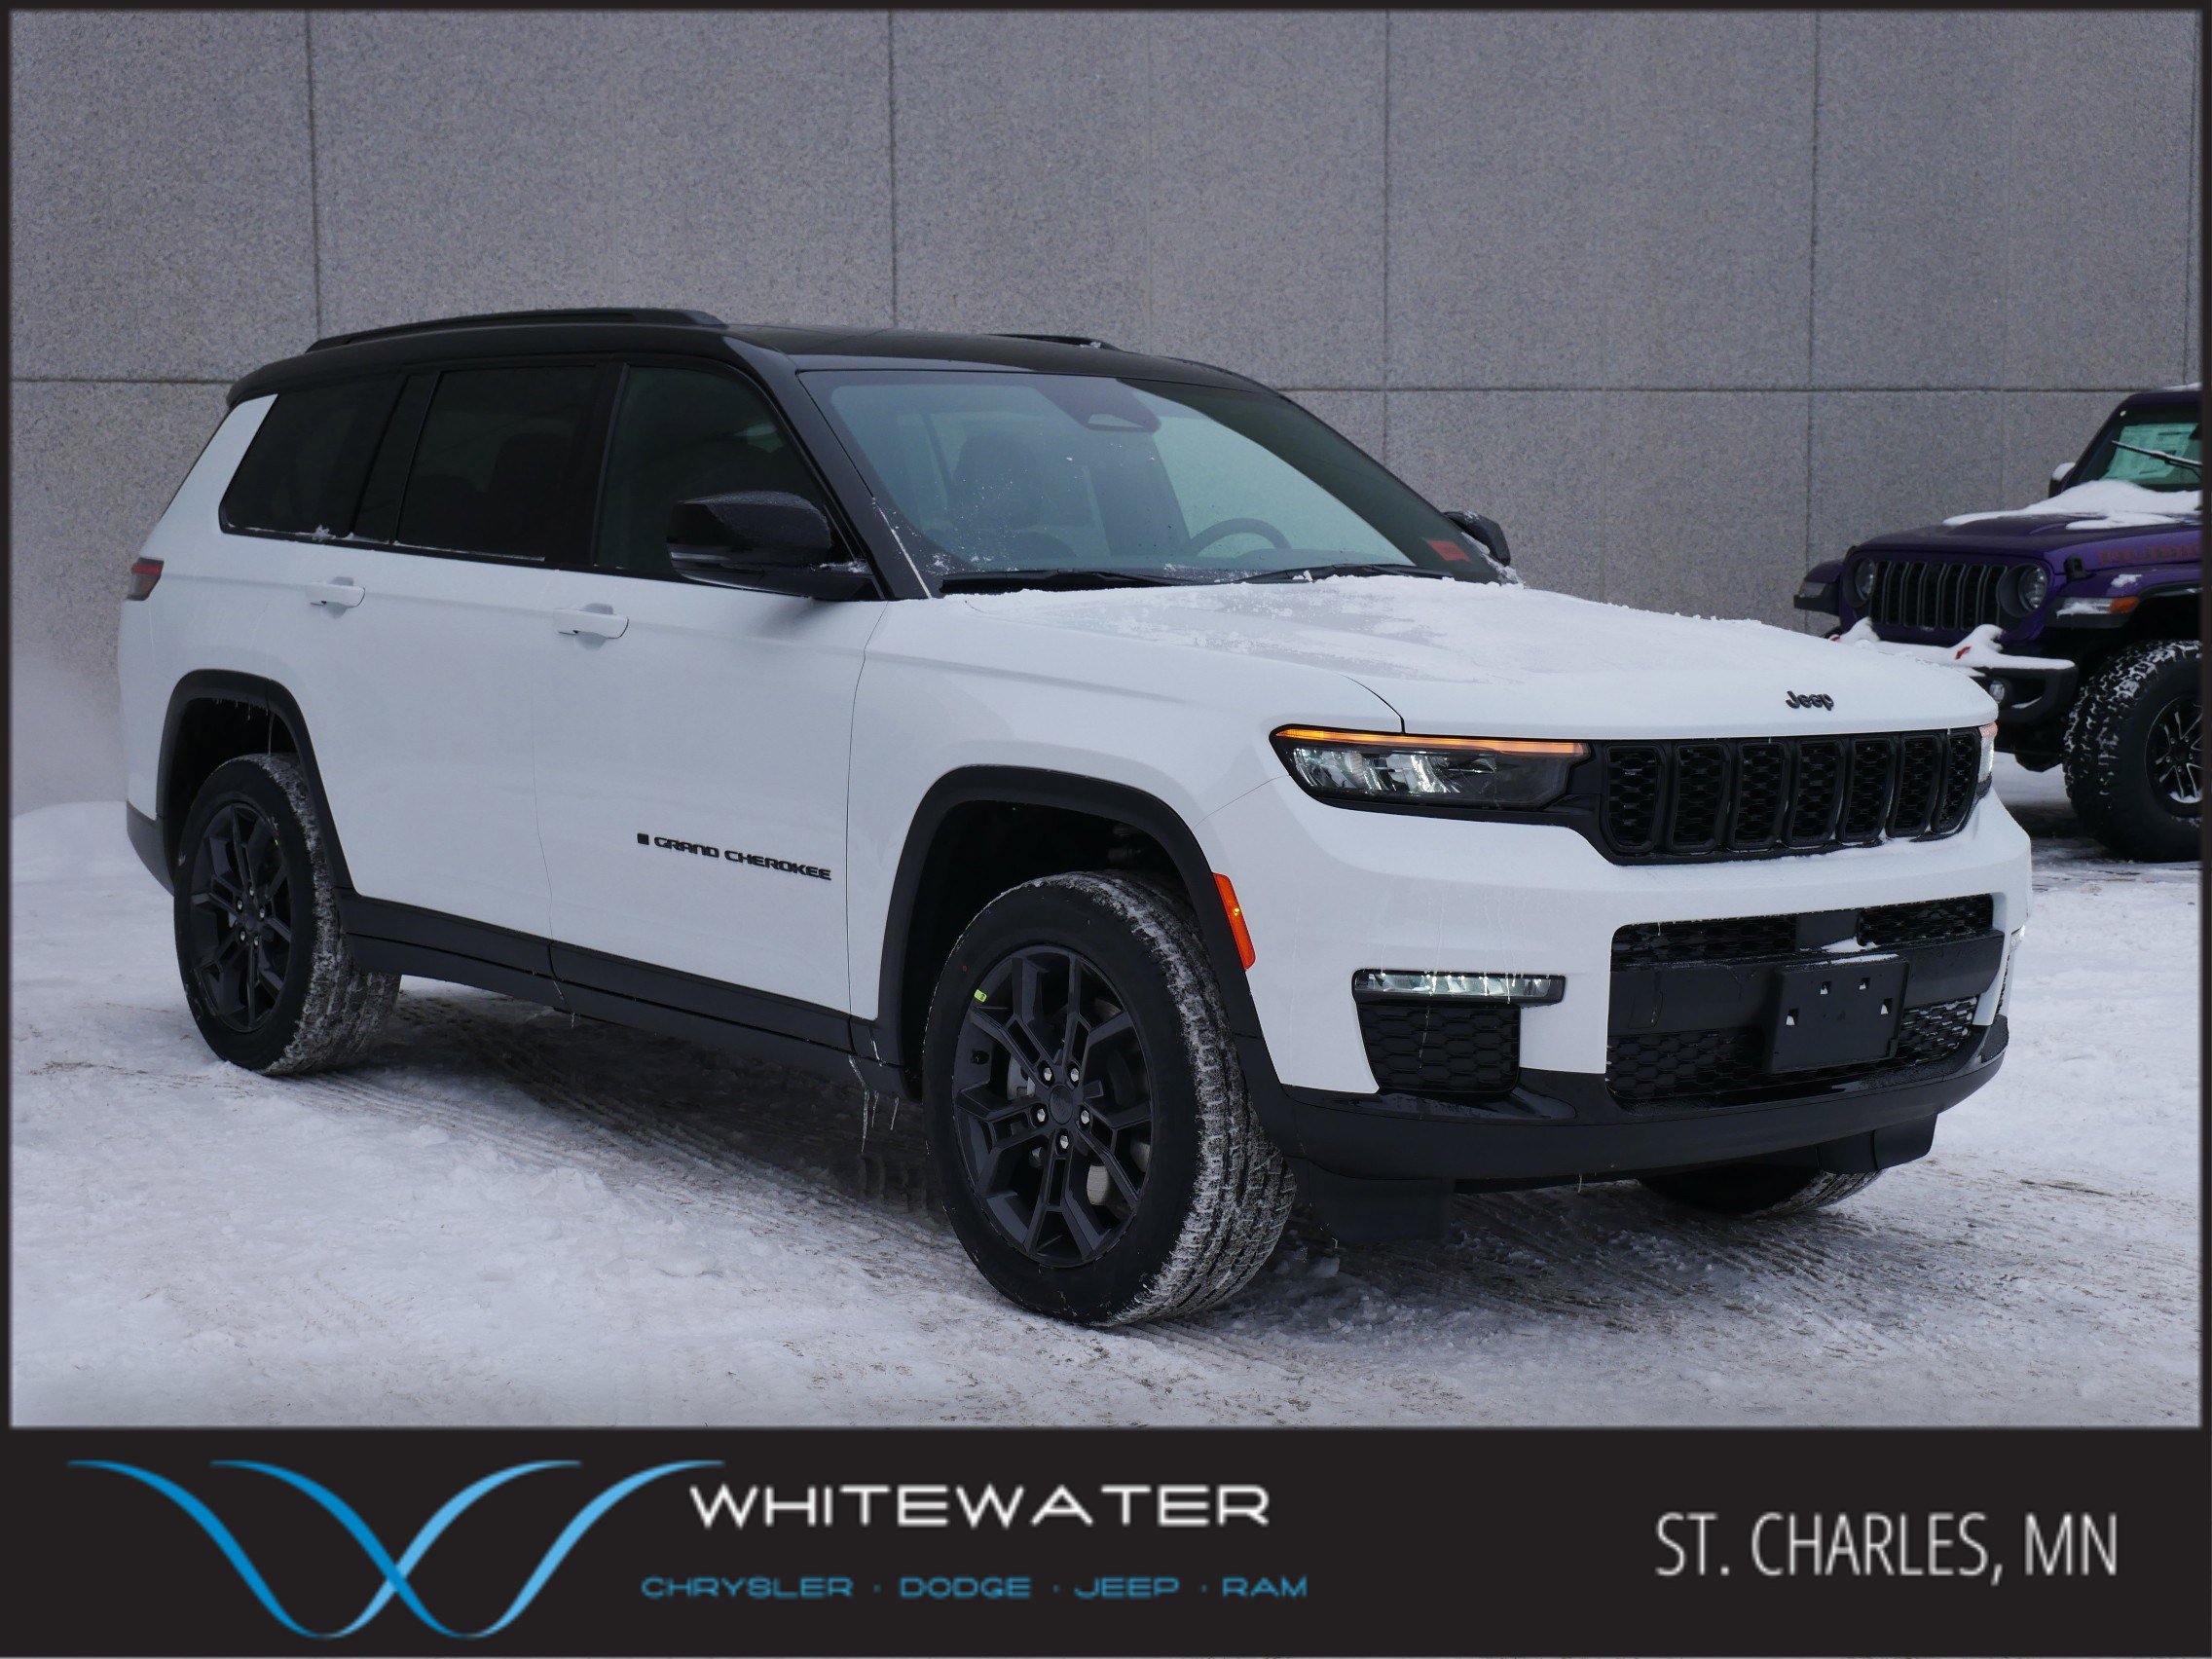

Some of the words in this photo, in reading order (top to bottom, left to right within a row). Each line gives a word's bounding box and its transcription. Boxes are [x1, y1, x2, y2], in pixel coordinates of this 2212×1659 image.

[1785, 689, 1834, 712] Jeep
[653, 835, 720, 859] GRAND
[723, 849, 832, 881] CHEROKEE
